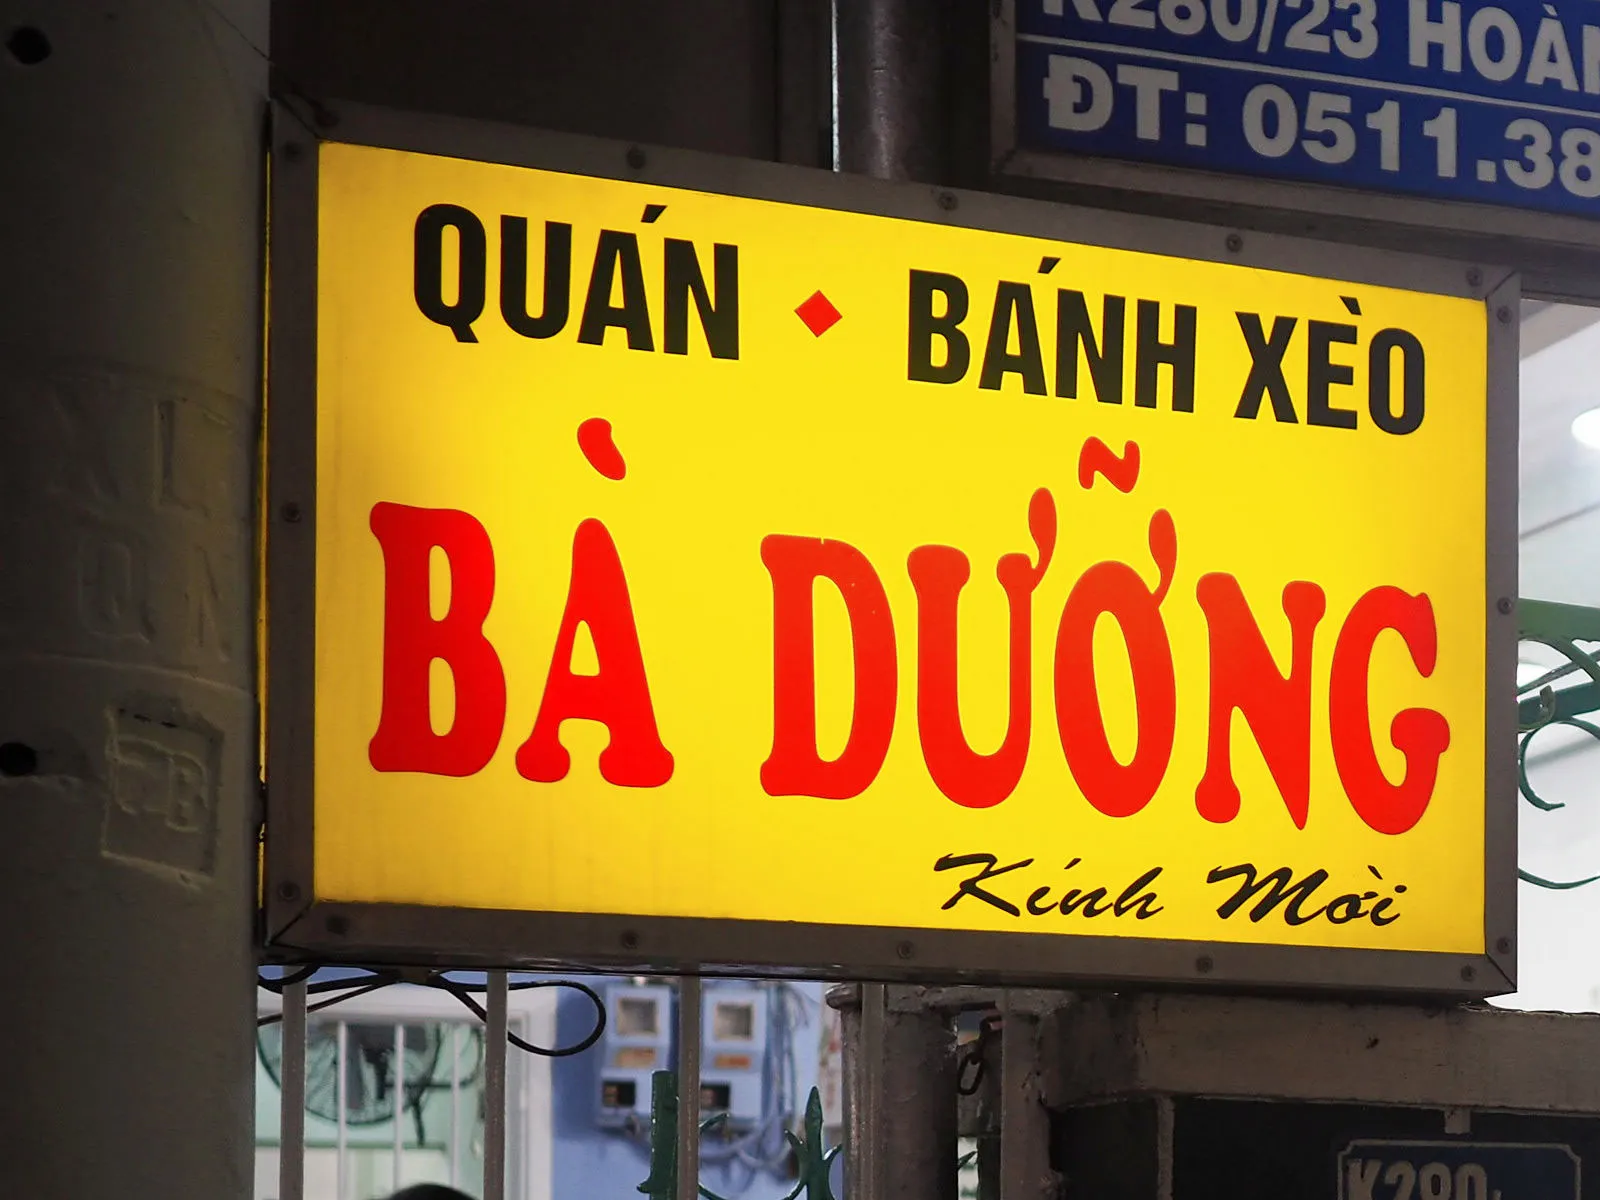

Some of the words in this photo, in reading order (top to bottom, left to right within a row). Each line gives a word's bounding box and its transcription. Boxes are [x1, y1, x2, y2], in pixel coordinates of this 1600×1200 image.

[1043, 54, 1207, 147] ĐT:
[412, 202, 740, 362] QUÁN
[907, 257, 1196, 413] BÁNH
[1233, 295, 1426, 436] XÈO
[368, 417, 675, 789] BÀ
[759, 435, 1451, 836] DƯỠNG
[932, 852, 1164, 920] Kính
[1206, 863, 1408, 927] Mời
